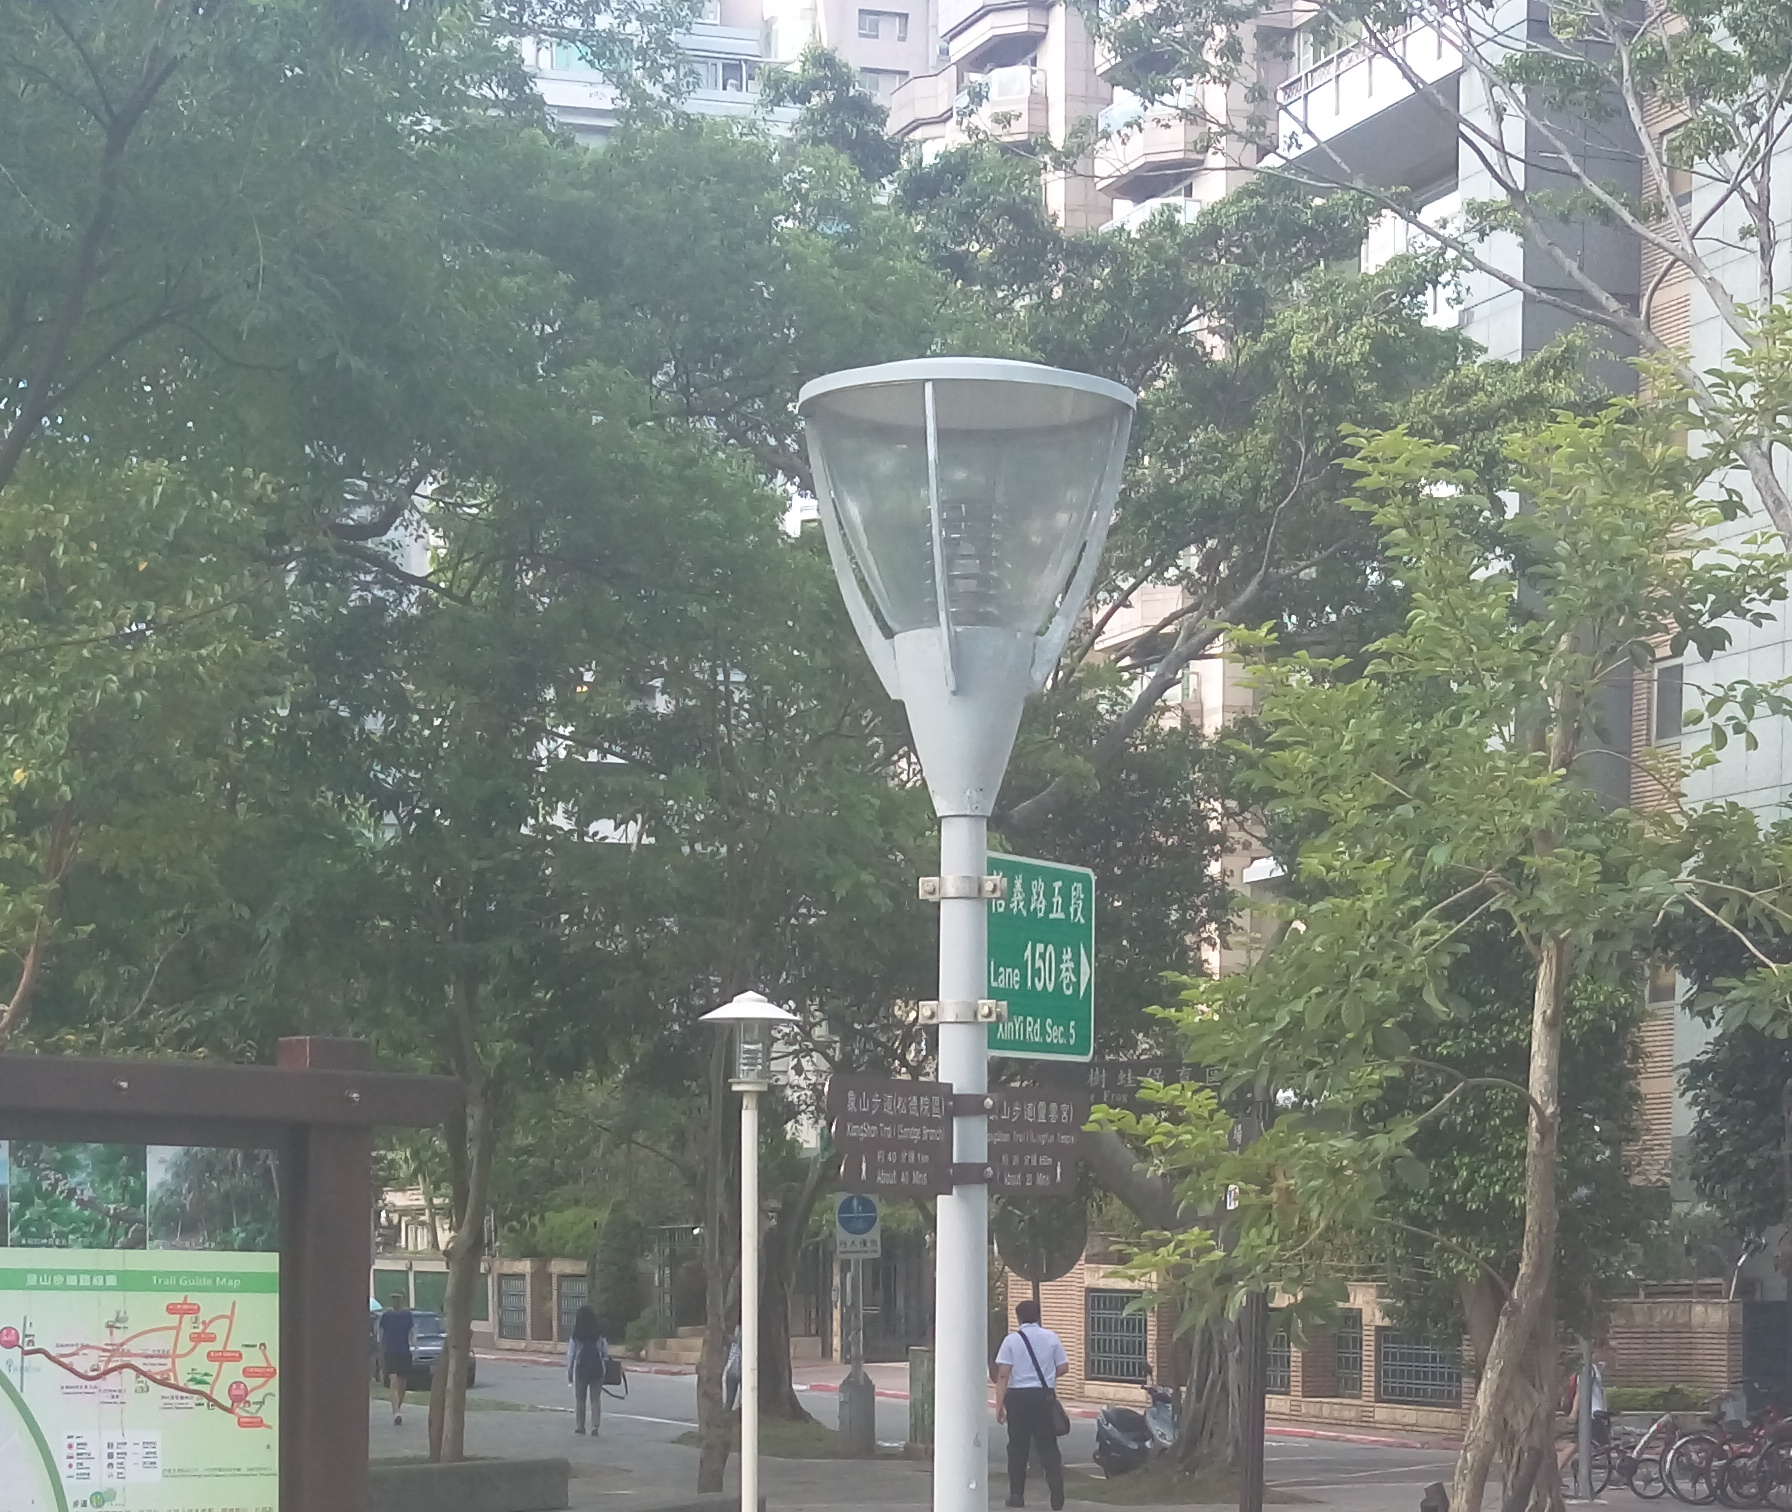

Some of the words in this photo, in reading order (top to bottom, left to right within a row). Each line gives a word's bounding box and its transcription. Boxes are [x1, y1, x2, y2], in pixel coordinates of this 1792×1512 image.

[990, 958, 1020, 990] Lane
[997, 1015, 1024, 1041] XinYi
[1026, 1016, 1043, 1042] Rd.
[1045, 1019, 1067, 1044] Sec.
[1069, 1020, 1076, 1046] 5
[887, 1151, 897, 1163] 40
[877, 1169, 897, 1184] About
[912, 1170, 928, 1185] Mins
[152, 1275, 177, 1286] Trail
[179, 1275, 213, 1286] Guide
[215, 1276, 241, 1288] Map
